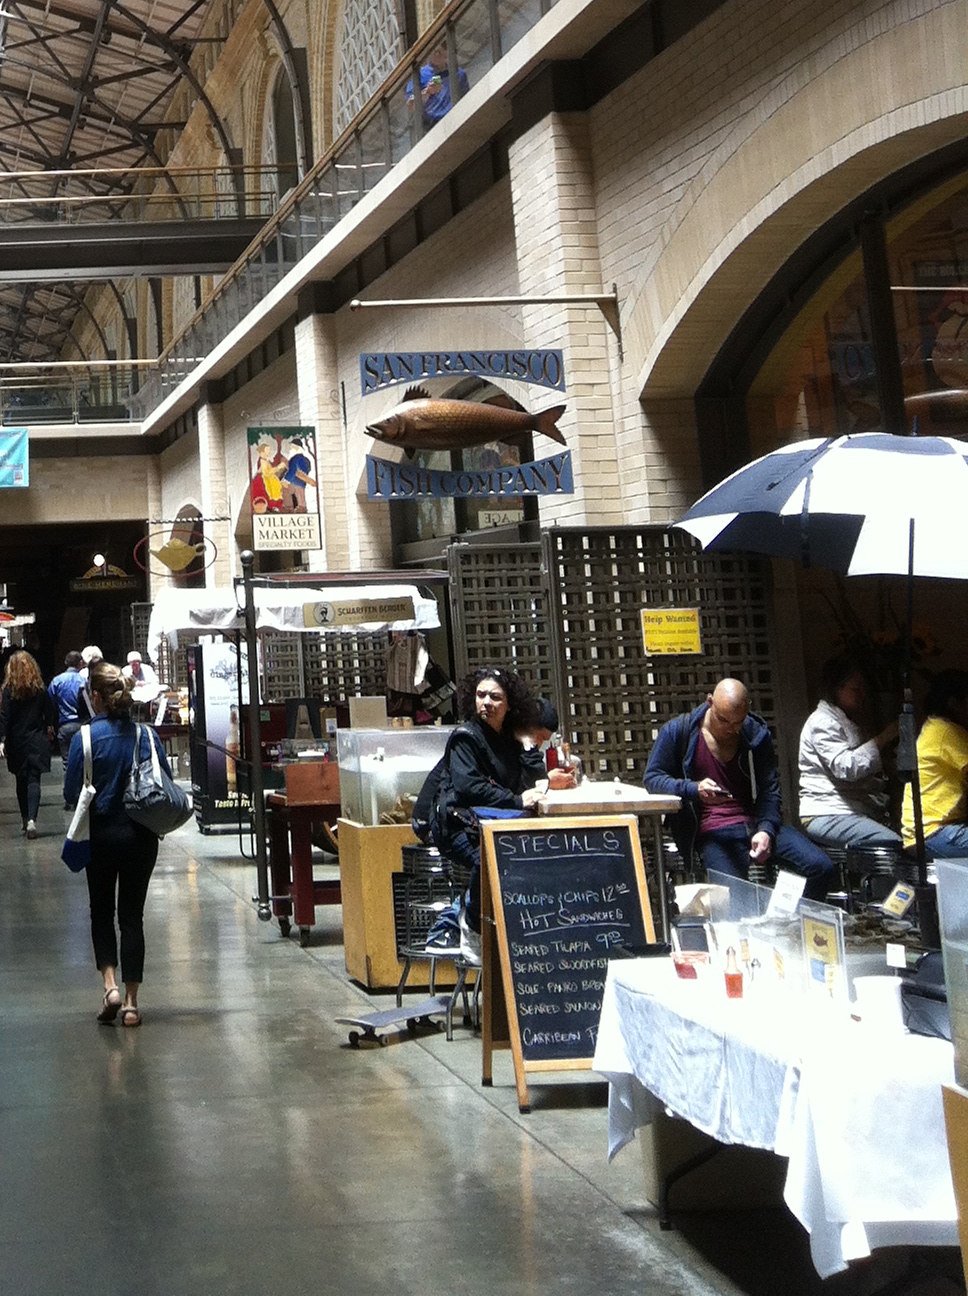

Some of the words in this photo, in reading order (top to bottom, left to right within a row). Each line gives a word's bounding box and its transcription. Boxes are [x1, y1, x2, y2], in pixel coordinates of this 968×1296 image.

[364, 353, 414, 392] SAN
[420, 351, 561, 388] FRANCISCO
[368, 458, 434, 497] FISH
[439, 454, 570, 495] COMPANY
[258, 515, 315, 528] VILLAGE
[258, 528, 315, 540] MARKET
[294, 540, 317, 548] FOODS
[644, 615, 663, 625] Help
[665, 614, 696, 623] Wanted
[498, 830, 620, 855] SPECIALS
[503, 891, 554, 906] SCALLOPS
[564, 890, 600, 904] CHIPS
[511, 942, 549, 957] SEARED
[550, 940, 592, 953] TILAPIA
[513, 961, 555, 974] SEARED
[519, 1003, 561, 1016] SEARED
